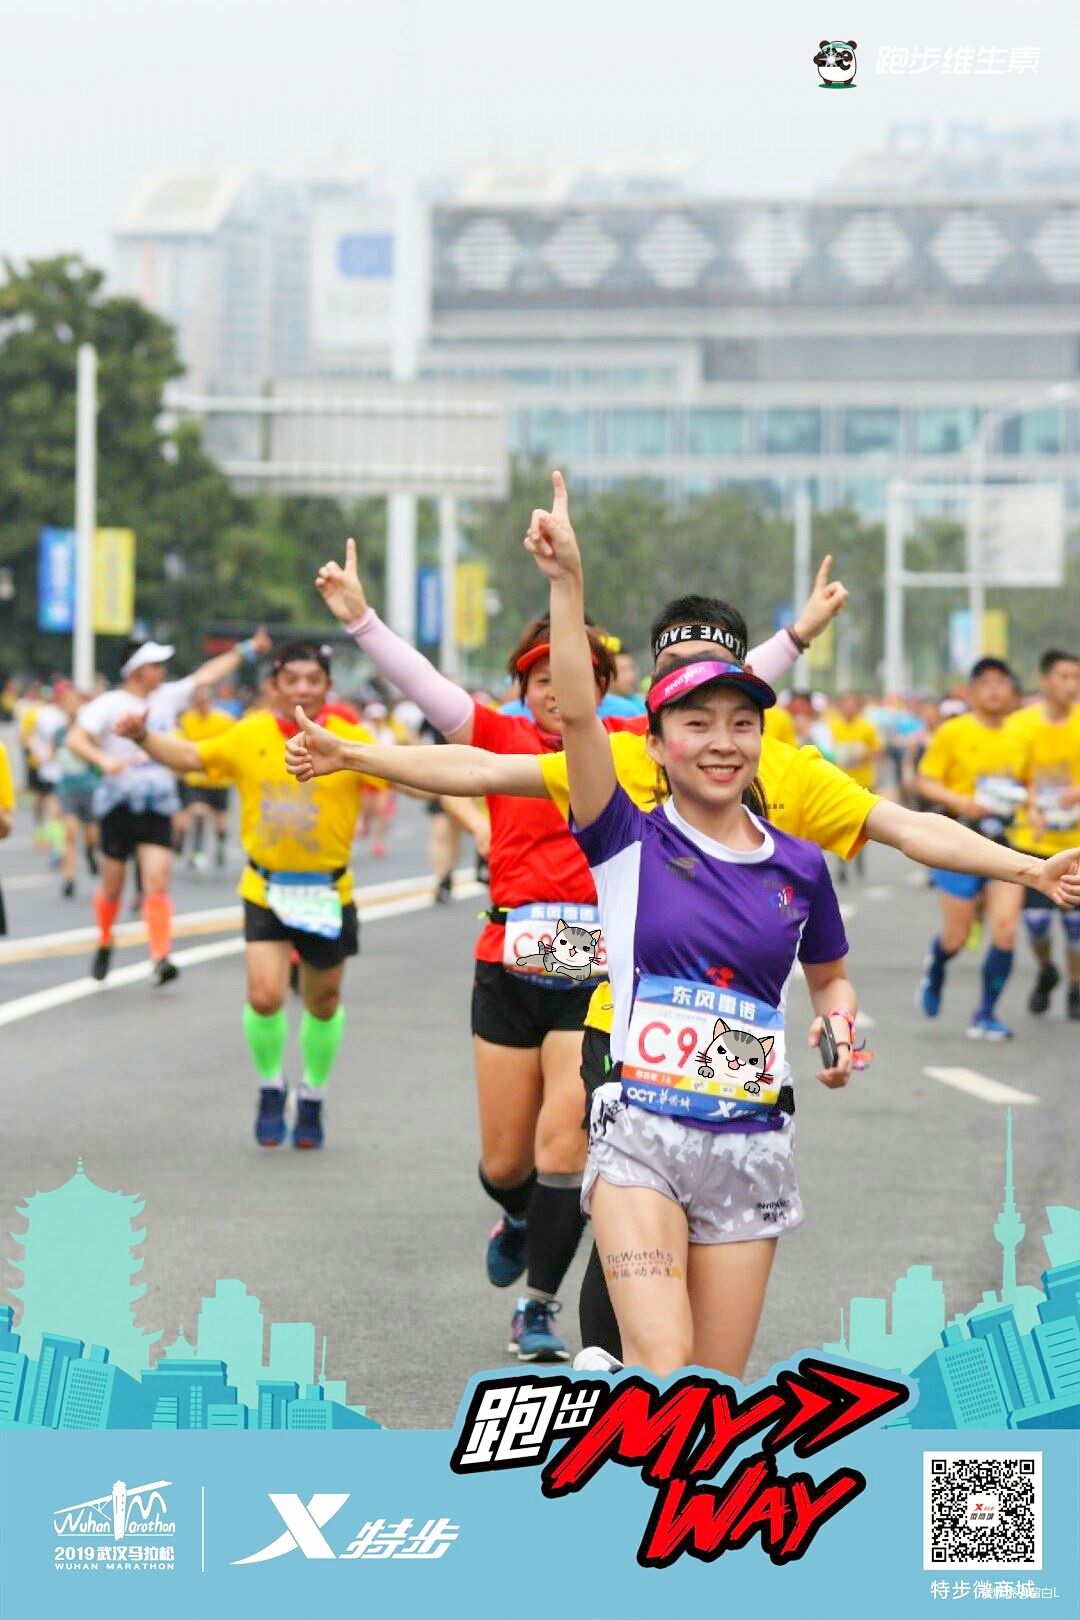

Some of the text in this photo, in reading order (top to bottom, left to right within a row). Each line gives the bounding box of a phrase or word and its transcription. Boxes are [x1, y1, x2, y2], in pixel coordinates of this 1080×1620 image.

[672, 985, 757, 1021] 东风雷诺
[627, 1087, 656, 1103] OCT
